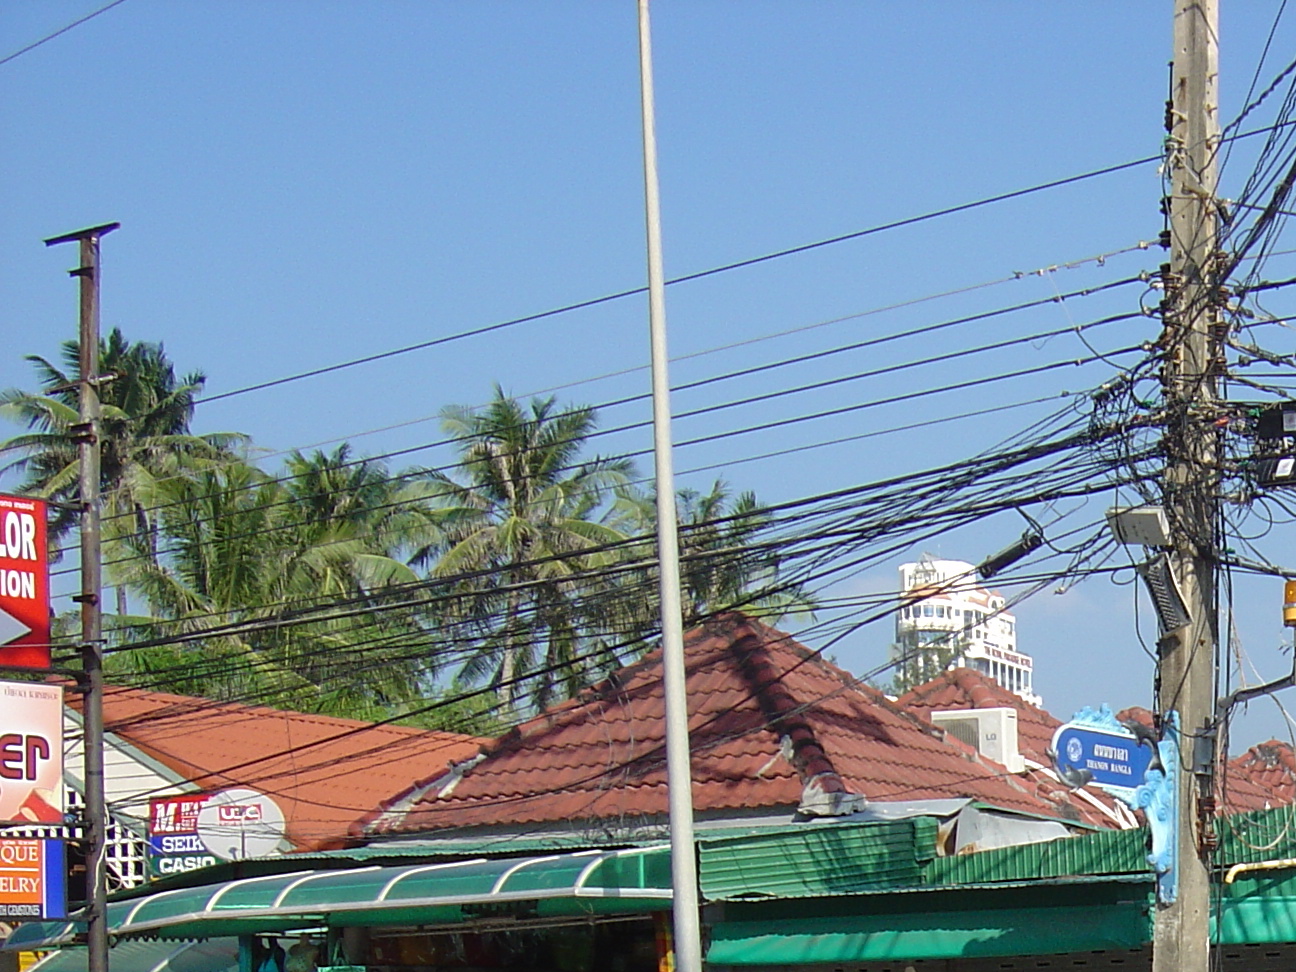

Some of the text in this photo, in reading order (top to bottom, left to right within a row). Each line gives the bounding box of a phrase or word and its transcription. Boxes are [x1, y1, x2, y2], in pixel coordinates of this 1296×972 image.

[986, 733, 997, 741] LG
[161, 836, 205, 853] SEIK
[160, 856, 216, 874] CASIO
